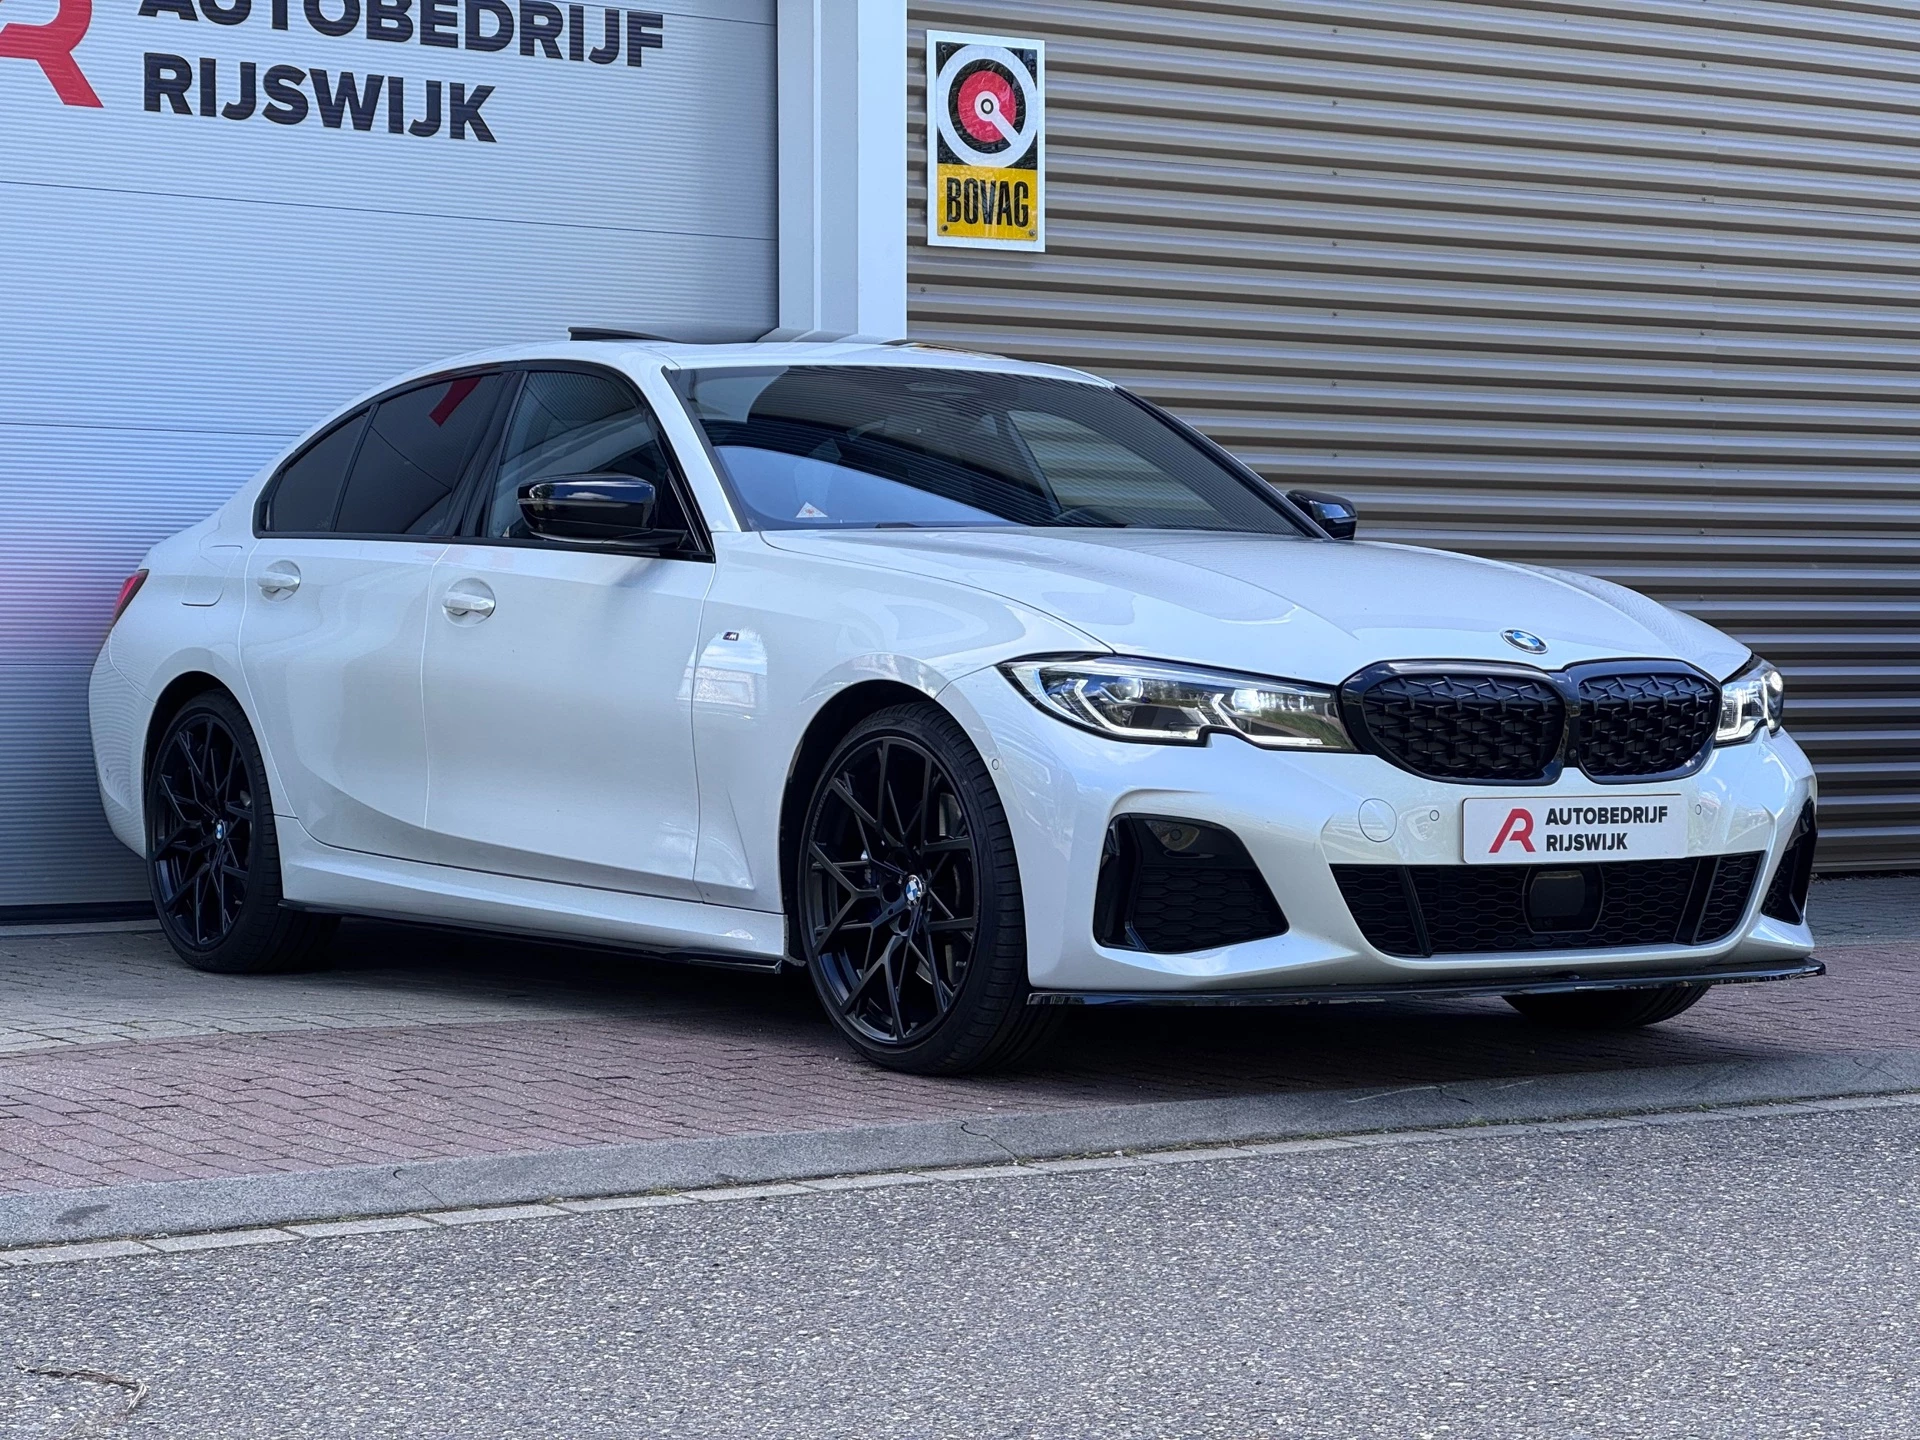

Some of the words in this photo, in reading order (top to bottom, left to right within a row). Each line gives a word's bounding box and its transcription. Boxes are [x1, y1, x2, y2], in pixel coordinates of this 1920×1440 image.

[138, 0, 664, 67] OBEDRIJF
[143, 52, 497, 142] RIJSWIJK
[946, 177, 1029, 228] BOVAG
[1545, 805, 1668, 826] AUTOBEDRIJF
[1546, 832, 1628, 852] RIJSWIJK
